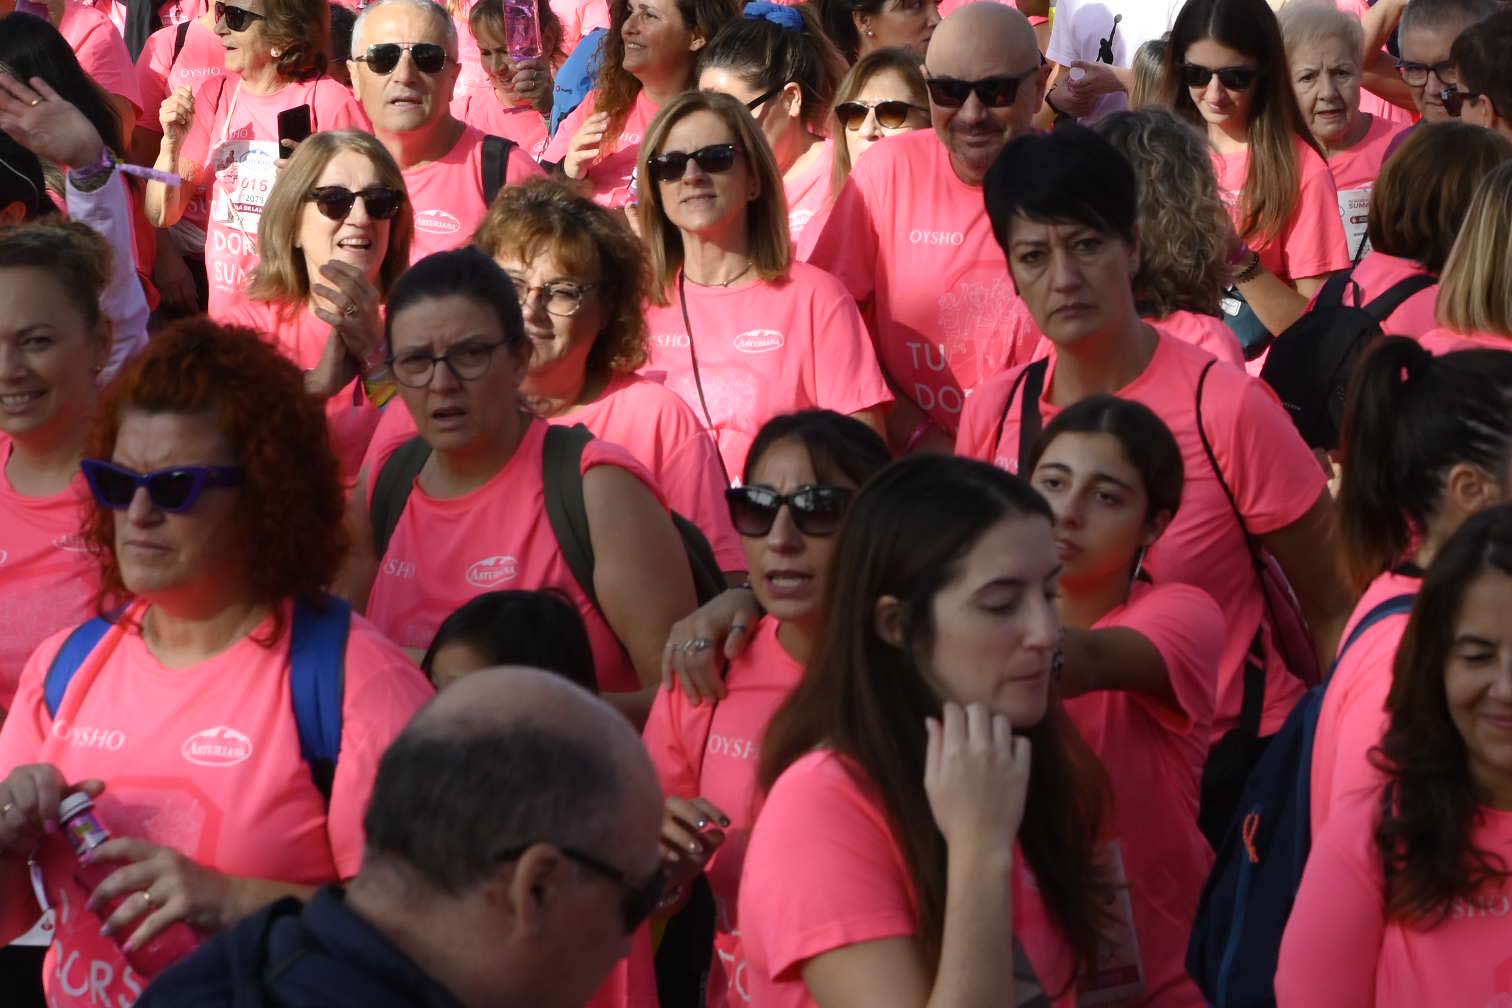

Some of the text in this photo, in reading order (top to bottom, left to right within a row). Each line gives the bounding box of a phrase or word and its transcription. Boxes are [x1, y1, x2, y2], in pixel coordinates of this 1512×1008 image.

[213, 230, 257, 255] DOR
[909, 229, 965, 246] OYSHO
[656, 334, 690, 348] SHO
[905, 341, 946, 372] TU
